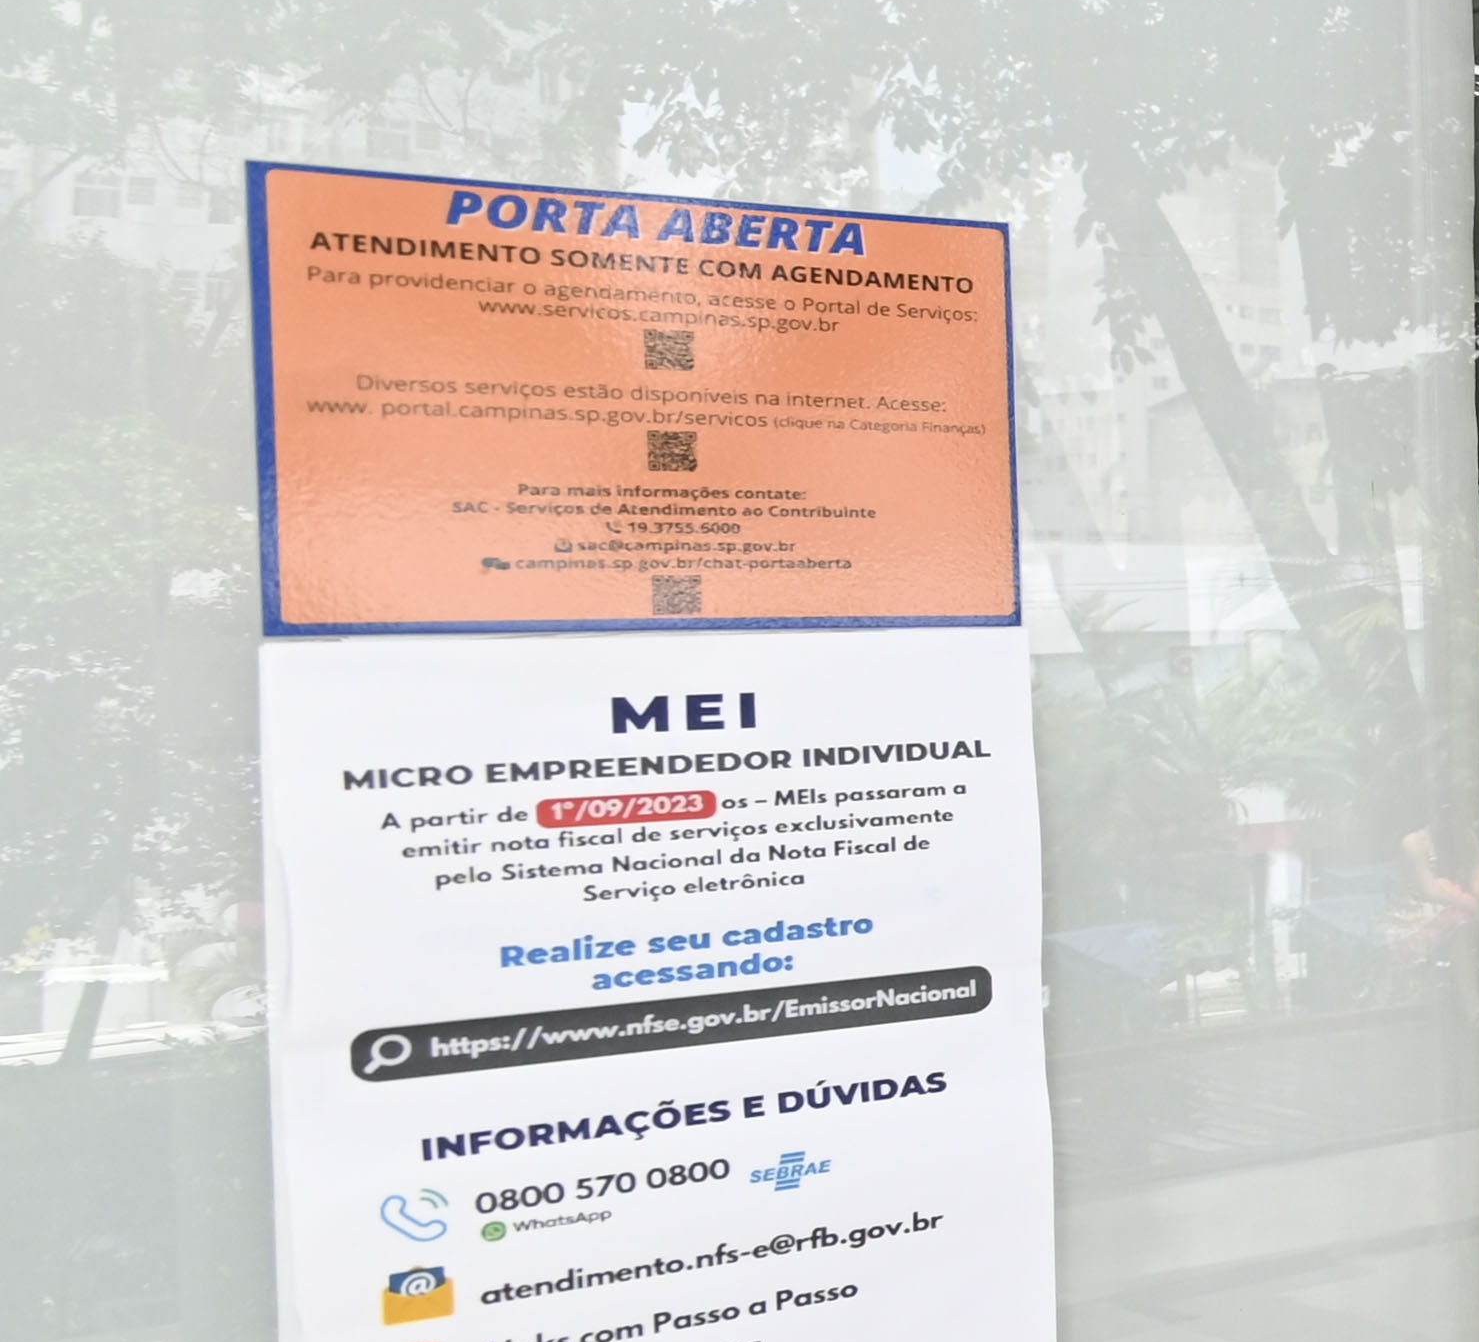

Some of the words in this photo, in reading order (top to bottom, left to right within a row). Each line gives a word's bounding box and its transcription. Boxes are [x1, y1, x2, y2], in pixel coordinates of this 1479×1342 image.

[445, 190, 643, 239] PORTA
[656, 208, 866, 256] ABERTA
[310, 232, 540, 266] ATENDIMENTO
[550, 249, 689, 275] SOMENTE
[699, 259, 762, 280] COM
[771, 265, 974, 294] AGENDAMENTO
[307, 265, 361, 286] Para
[369, 270, 515, 296] providenciar
[523, 282, 537, 296] o
[545, 284, 700, 307] agendamento,
[708, 293, 776, 311] acesse
[784, 297, 796, 311] o
[803, 297, 860, 315] Portal
[867, 300, 890, 317] de
[897, 302, 978, 324] Serviços:
[306, 400, 373, 415] www.
[828, 420, 845, 430] na
[850, 418, 917, 434] Categoria
[356, 374, 457, 394] Diversos
[465, 379, 557, 401] serviços
[564, 382, 623, 401] estão
[631, 386, 748, 407] disponíveis
[755, 392, 779, 407] na
[787, 394, 871, 410] internet.
[877, 396, 947, 412] Acesse:
[452, 500, 488, 514] SAC
[506, 501, 584, 518] Serviços
[590, 502, 612, 516] de
[617, 502, 736, 518] Atendimento
[742, 508, 762, 518] ao
[768, 505, 877, 519] Contribuinte
[518, 483, 560, 497] Para
[567, 483, 611, 498] mais
[617, 485, 730, 501] informações
[735, 487, 807, 501] contate:
[611, 692, 757, 734] MEI
[342, 765, 473, 791] MICRO
[485, 750, 792, 784] EMPREENDEDOR
[802, 739, 991, 767] INDIVIDUAL
[380, 812, 400, 830] A
[410, 808, 488, 833] partir
[497, 806, 528, 824] de
[721, 796, 749, 810] os
[774, 788, 827, 806] MEIs
[835, 783, 946, 808] passaram
[953, 781, 967, 795] a
[402, 837, 482, 859] emitir
[491, 834, 550, 853] nota
[558, 827, 623, 848] fiscal
[632, 826, 661, 845] de
[669, 821, 768, 841] serviços
[775, 808, 954, 834] exclusivamente
[435, 867, 492, 891] pelo
[501, 857, 603, 881] Sistema
[612, 849, 722, 873] Nacional
[730, 847, 760, 864] da
[769, 843, 827, 861] Nota
[834, 837, 897, 857] Fiscal
[903, 835, 930, 852] de
[583, 881, 676, 902] Serviço
[684, 871, 805, 893] eletrônica
[499, 934, 636, 967] Realize
[648, 932, 711, 955] seu
[722, 917, 873, 948] cadastro
[592, 953, 794, 991] acessando:
[430, 979, 977, 1059] https://www.nfse.gov.br/EmissorNacional
[421, 1099, 732, 1161] INFORMAÇÕES
[743, 1095, 765, 1119] E
[777, 1071, 948, 1114] DÚVIDAS
[474, 1183, 565, 1215] 0800
[575, 1172, 637, 1200] 570
[646, 1158, 731, 1189] 0800
[749, 1159, 832, 1184] SEBRAE
[512, 1208, 613, 1234] WhatsApp
[480, 1212, 944, 1305] atendimento.nfs-e@rfb.gov.br
[653, 1305, 741, 1334] Passo
[748, 1300, 767, 1316] a
[775, 1283, 859, 1311] Passo
